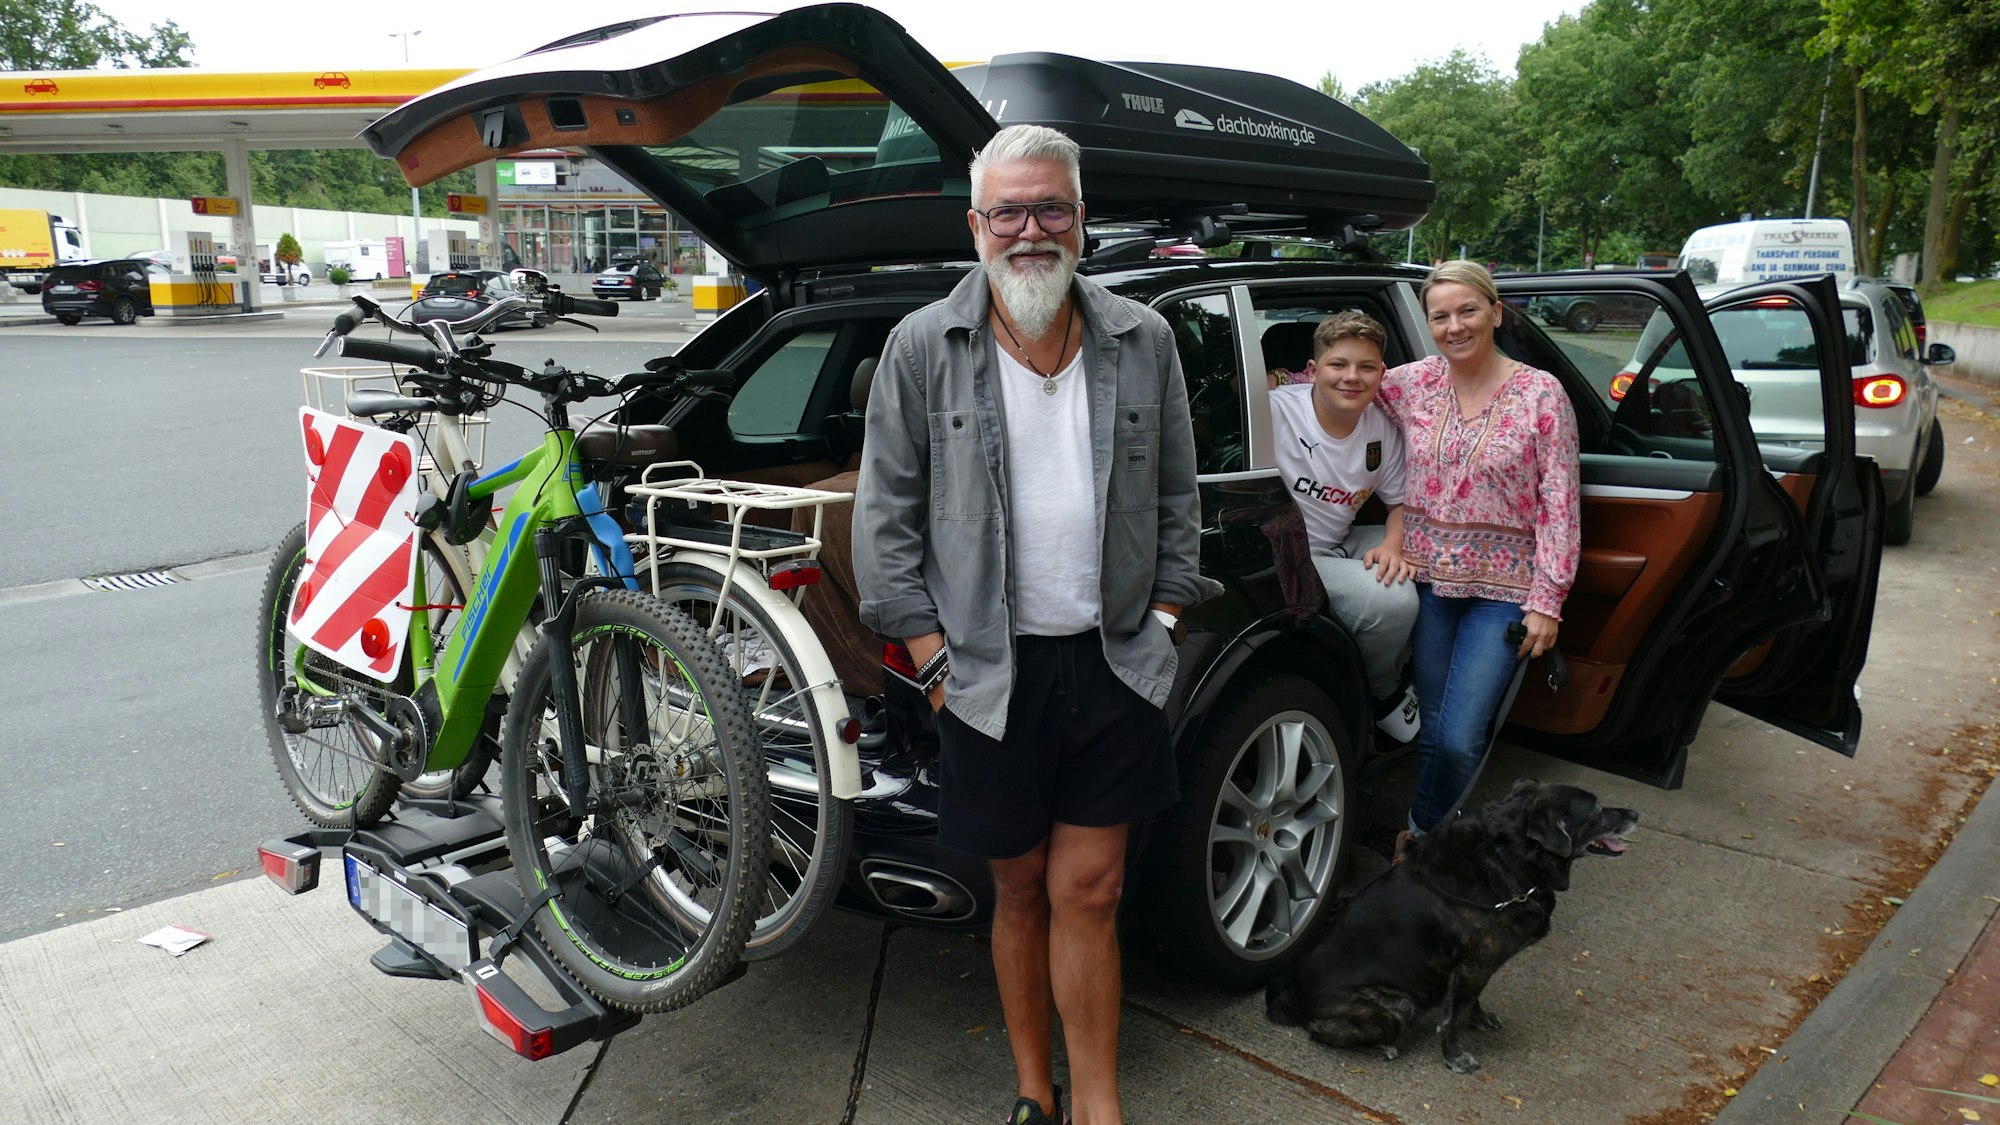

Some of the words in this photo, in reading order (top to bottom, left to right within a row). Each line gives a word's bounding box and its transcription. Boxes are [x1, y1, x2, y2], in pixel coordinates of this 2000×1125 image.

[1121, 92, 1165, 114] THULE
[1216, 113, 1316, 146] dachboxking.de
[197, 200, 204, 211] 7
[453, 197, 459, 208] 9
[1756, 250, 1800, 258] TRANSPORT
[1803, 250, 1840, 258] PERSOANE
[1783, 263, 1820, 272] GERMANIA
